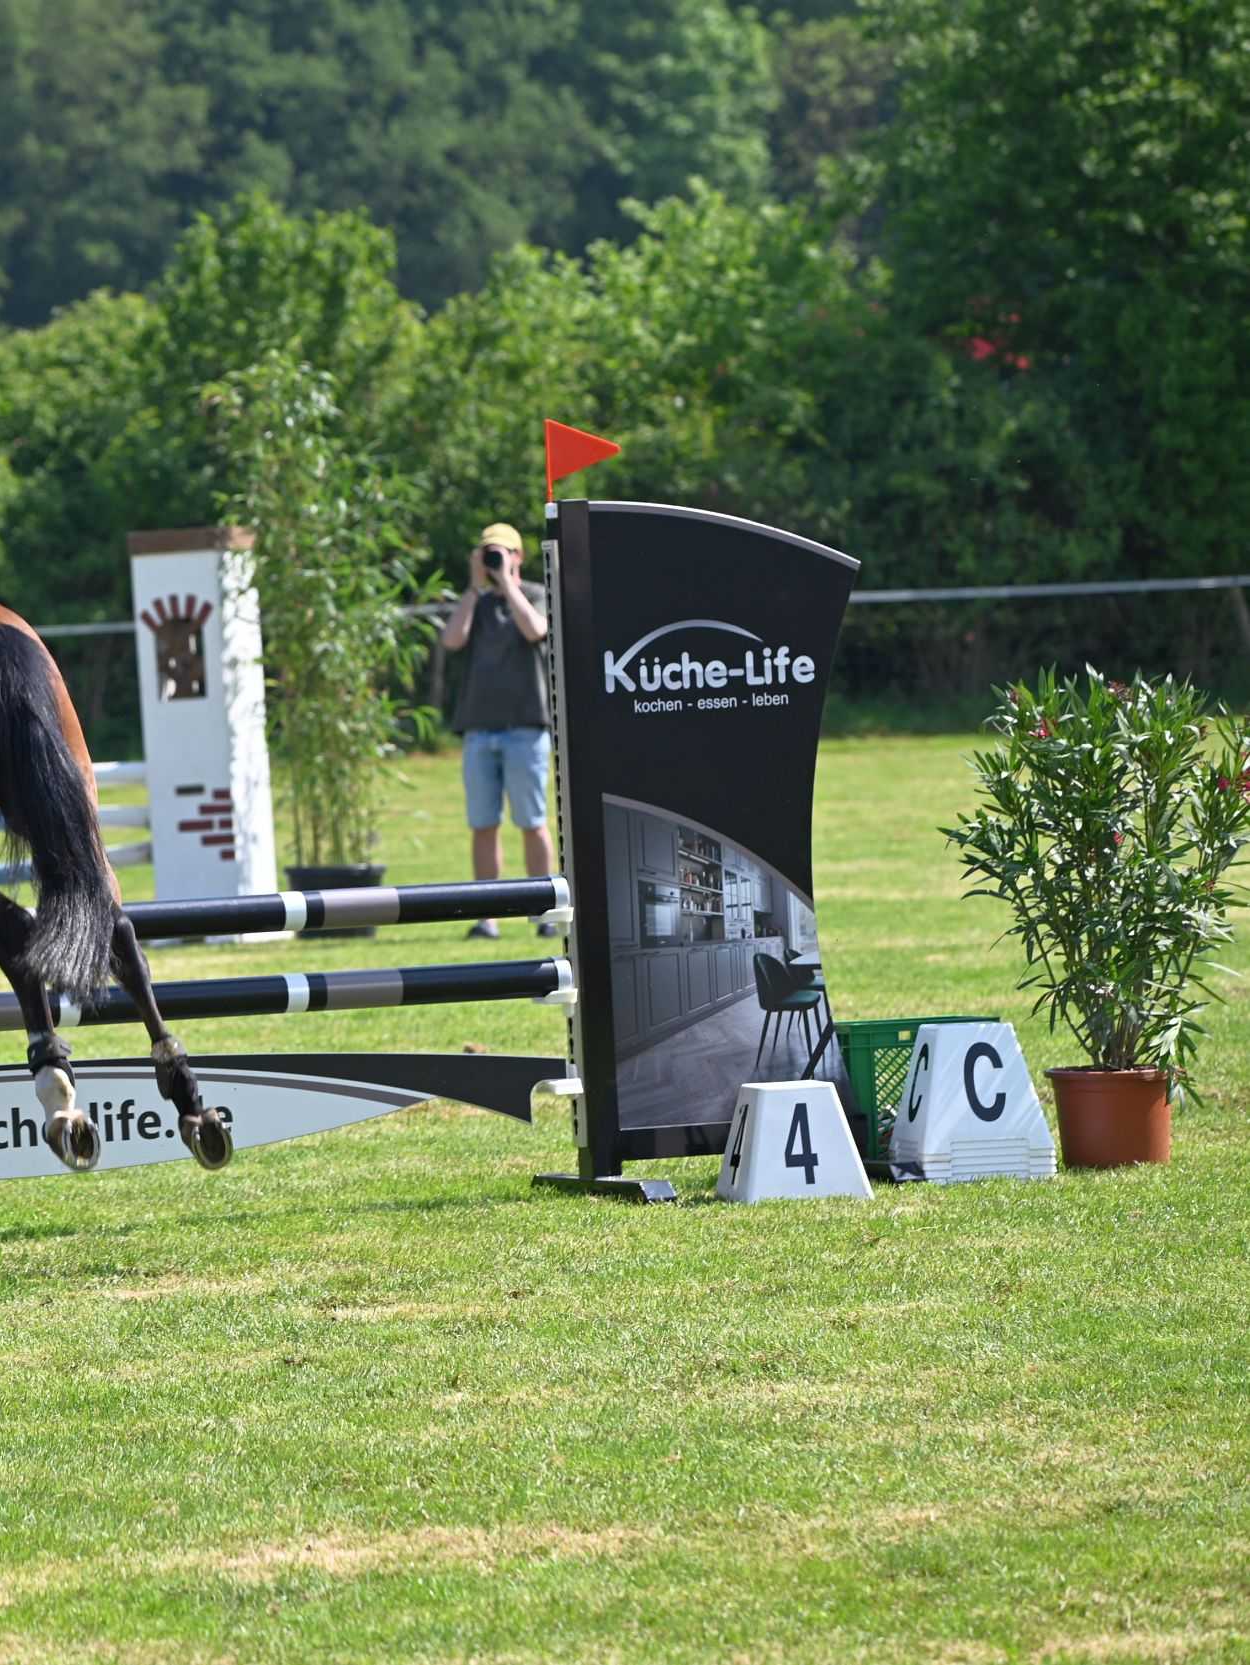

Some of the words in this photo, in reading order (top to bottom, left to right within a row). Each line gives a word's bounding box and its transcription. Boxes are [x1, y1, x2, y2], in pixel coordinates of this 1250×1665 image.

[604, 646, 816, 694] Küche-Life
[634, 698, 683, 713] kochen
[697, 696, 738, 710] essen
[752, 692, 789, 706] leben
[908, 1043, 929, 1123] C
[963, 1041, 1007, 1123] C
[784, 1102, 819, 1185] 4
